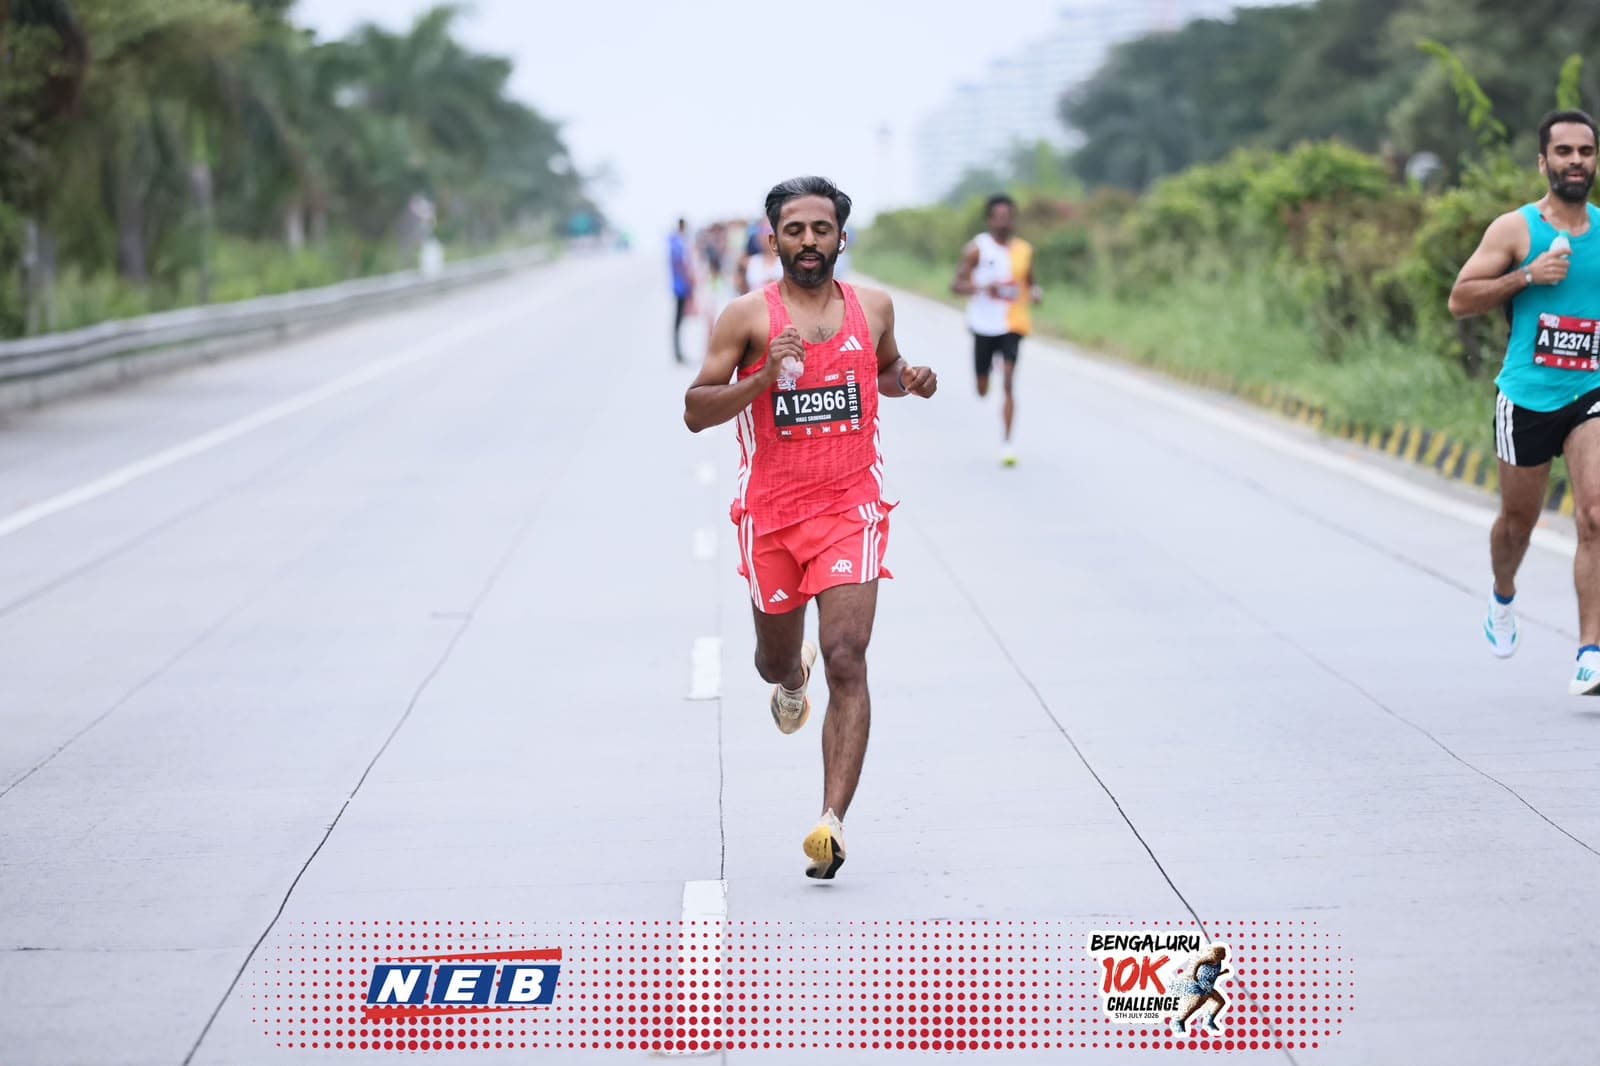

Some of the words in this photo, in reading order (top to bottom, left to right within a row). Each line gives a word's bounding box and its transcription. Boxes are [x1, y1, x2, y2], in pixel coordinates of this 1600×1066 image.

[1537, 329, 1549, 346] A
[1553, 331, 1591, 351] 12374
[846, 370, 858, 411] TOUGHER
[776, 396, 789, 415] A
[792, 390, 845, 414] 12966
[850, 414, 860, 430] 10K
